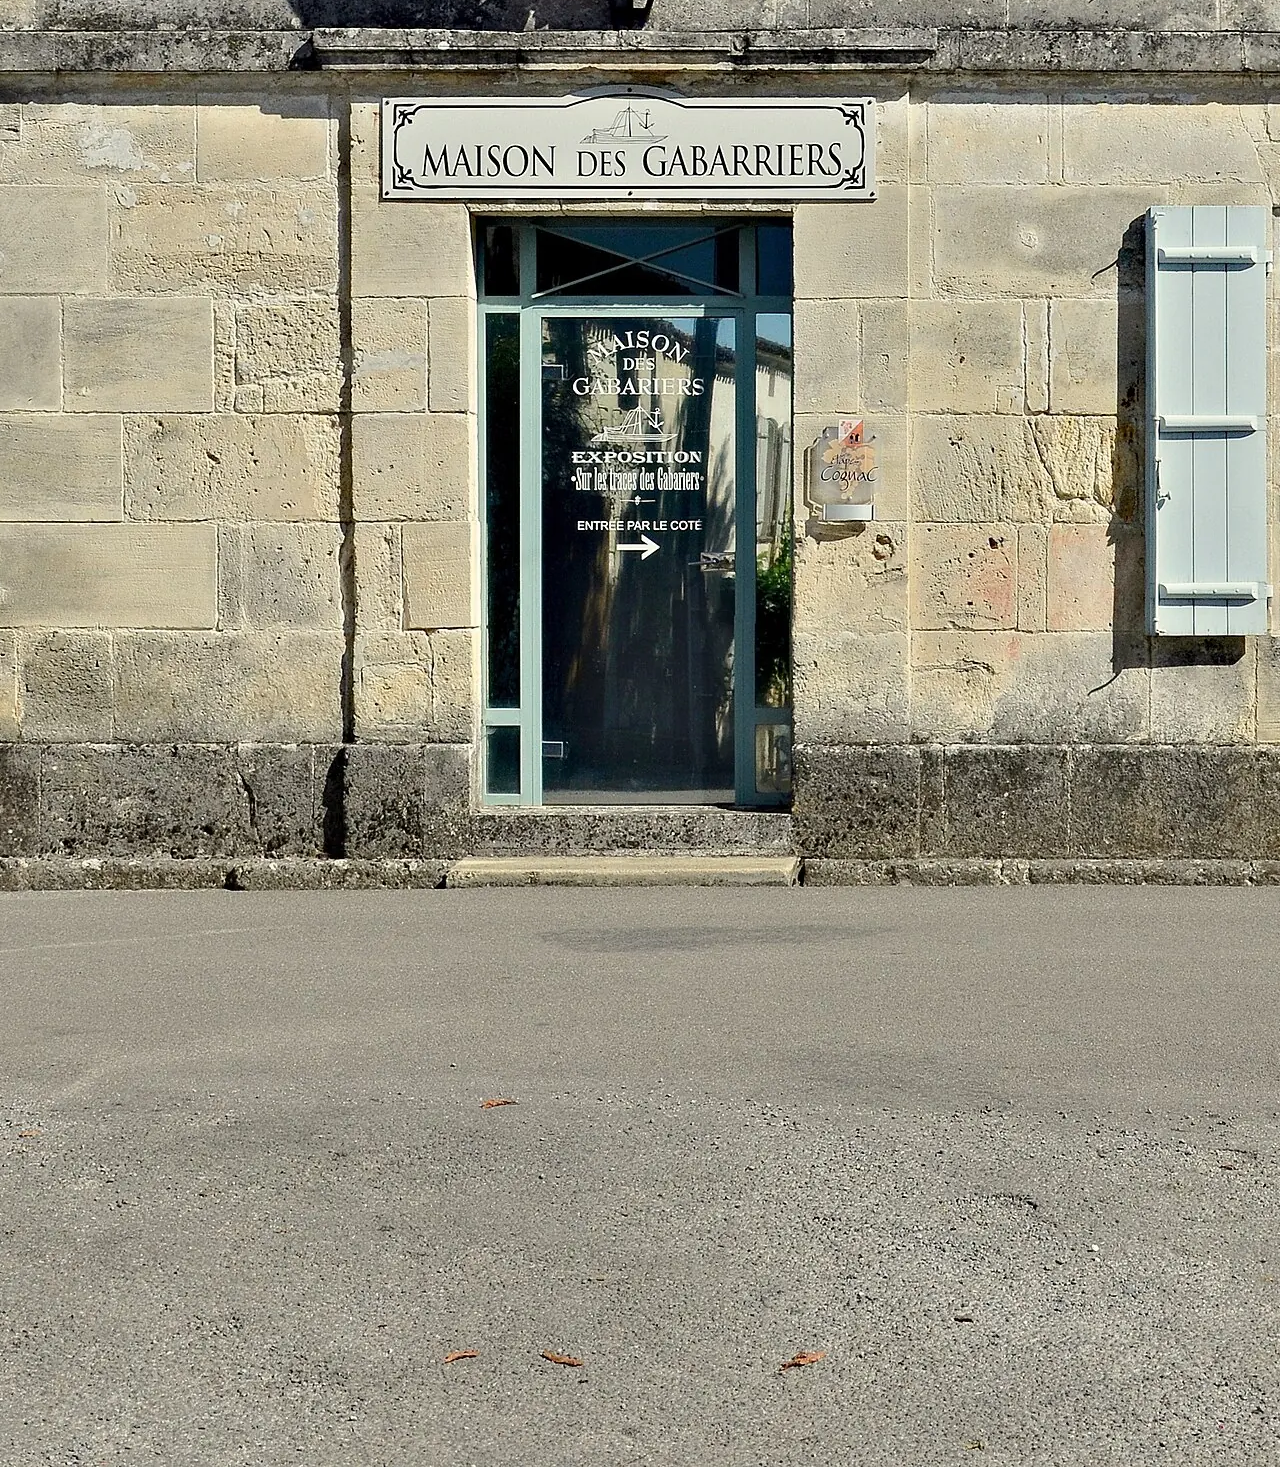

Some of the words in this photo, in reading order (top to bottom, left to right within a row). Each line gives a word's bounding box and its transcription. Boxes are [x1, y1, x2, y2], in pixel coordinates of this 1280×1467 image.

[421, 143, 556, 177] MAISON
[577, 150, 626, 177] DES
[642, 142, 842, 177] GABARRIERS
[587, 330, 690, 365] MAISON
[622, 357, 656, 371] DES
[572, 376, 705, 396] GABARIERS
[571, 451, 702, 464] EXPOSITION
[576, 467, 592, 491] Sur
[593, 467, 607, 491] les
[609, 468, 637, 491] traces
[640, 467, 655, 491] des
[657, 467, 700, 491] Gabariers
[627, 520, 650, 531] PAR
[653, 520, 667, 531] LE
